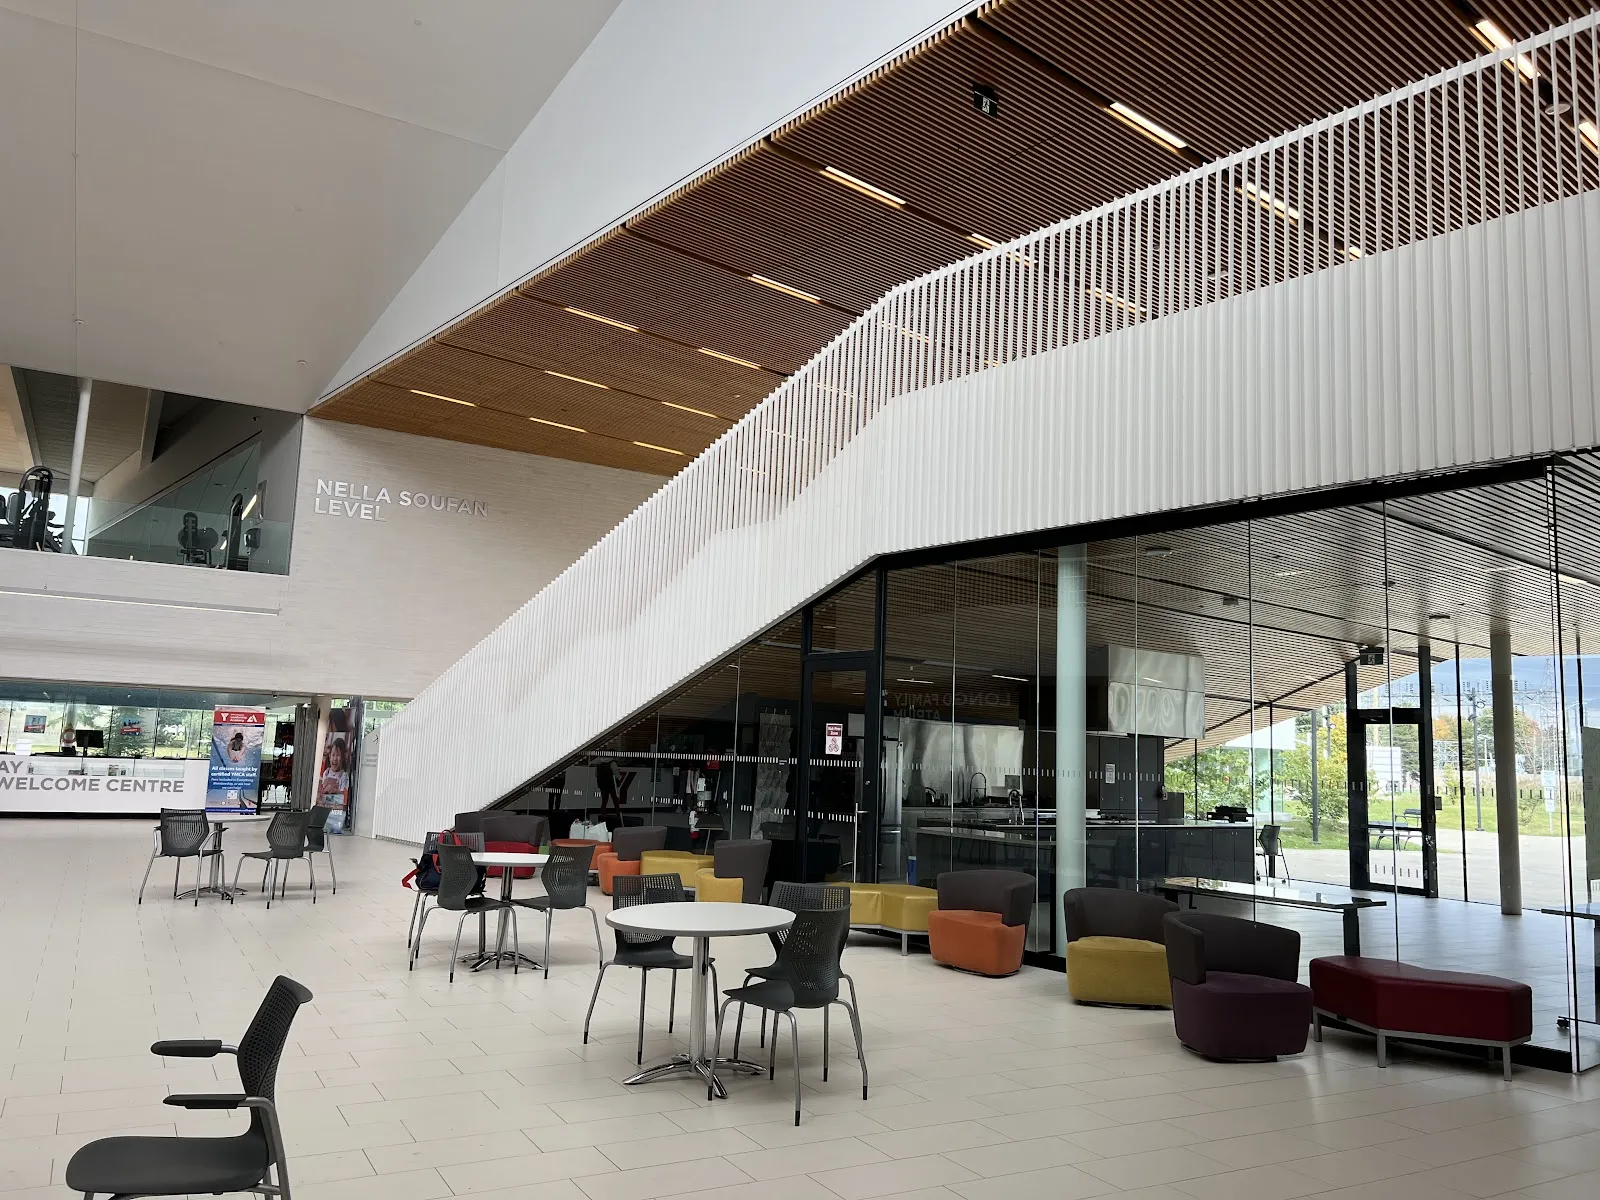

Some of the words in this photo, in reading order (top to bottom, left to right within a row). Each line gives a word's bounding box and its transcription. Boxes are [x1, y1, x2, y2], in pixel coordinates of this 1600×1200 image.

[314, 497, 387, 522] LEVEL
[316, 478, 391, 503] NELLA
[399, 490, 489, 517] SOUFAN
[0, 776, 100, 792] WELCOME
[106, 778, 185, 793] CENTRE
